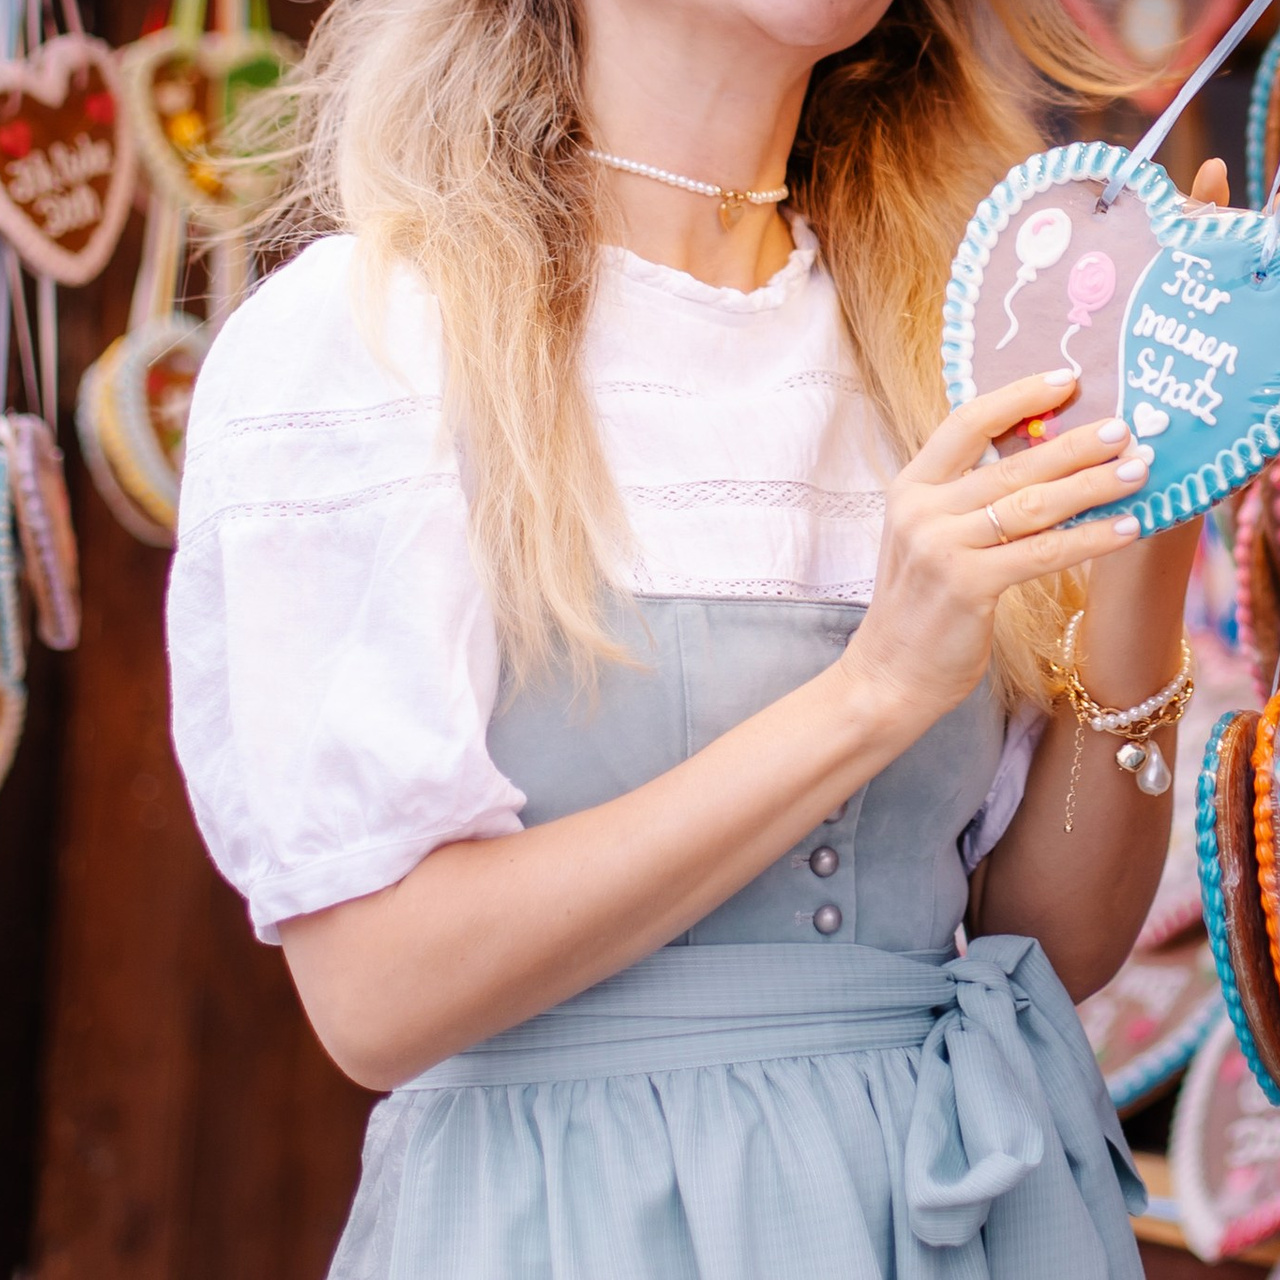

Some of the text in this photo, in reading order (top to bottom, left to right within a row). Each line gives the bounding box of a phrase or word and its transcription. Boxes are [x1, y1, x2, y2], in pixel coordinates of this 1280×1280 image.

[1161, 251, 1231, 315] Für
[1132, 303, 1239, 376] meinen
[1127, 347, 1224, 426] Schatz
